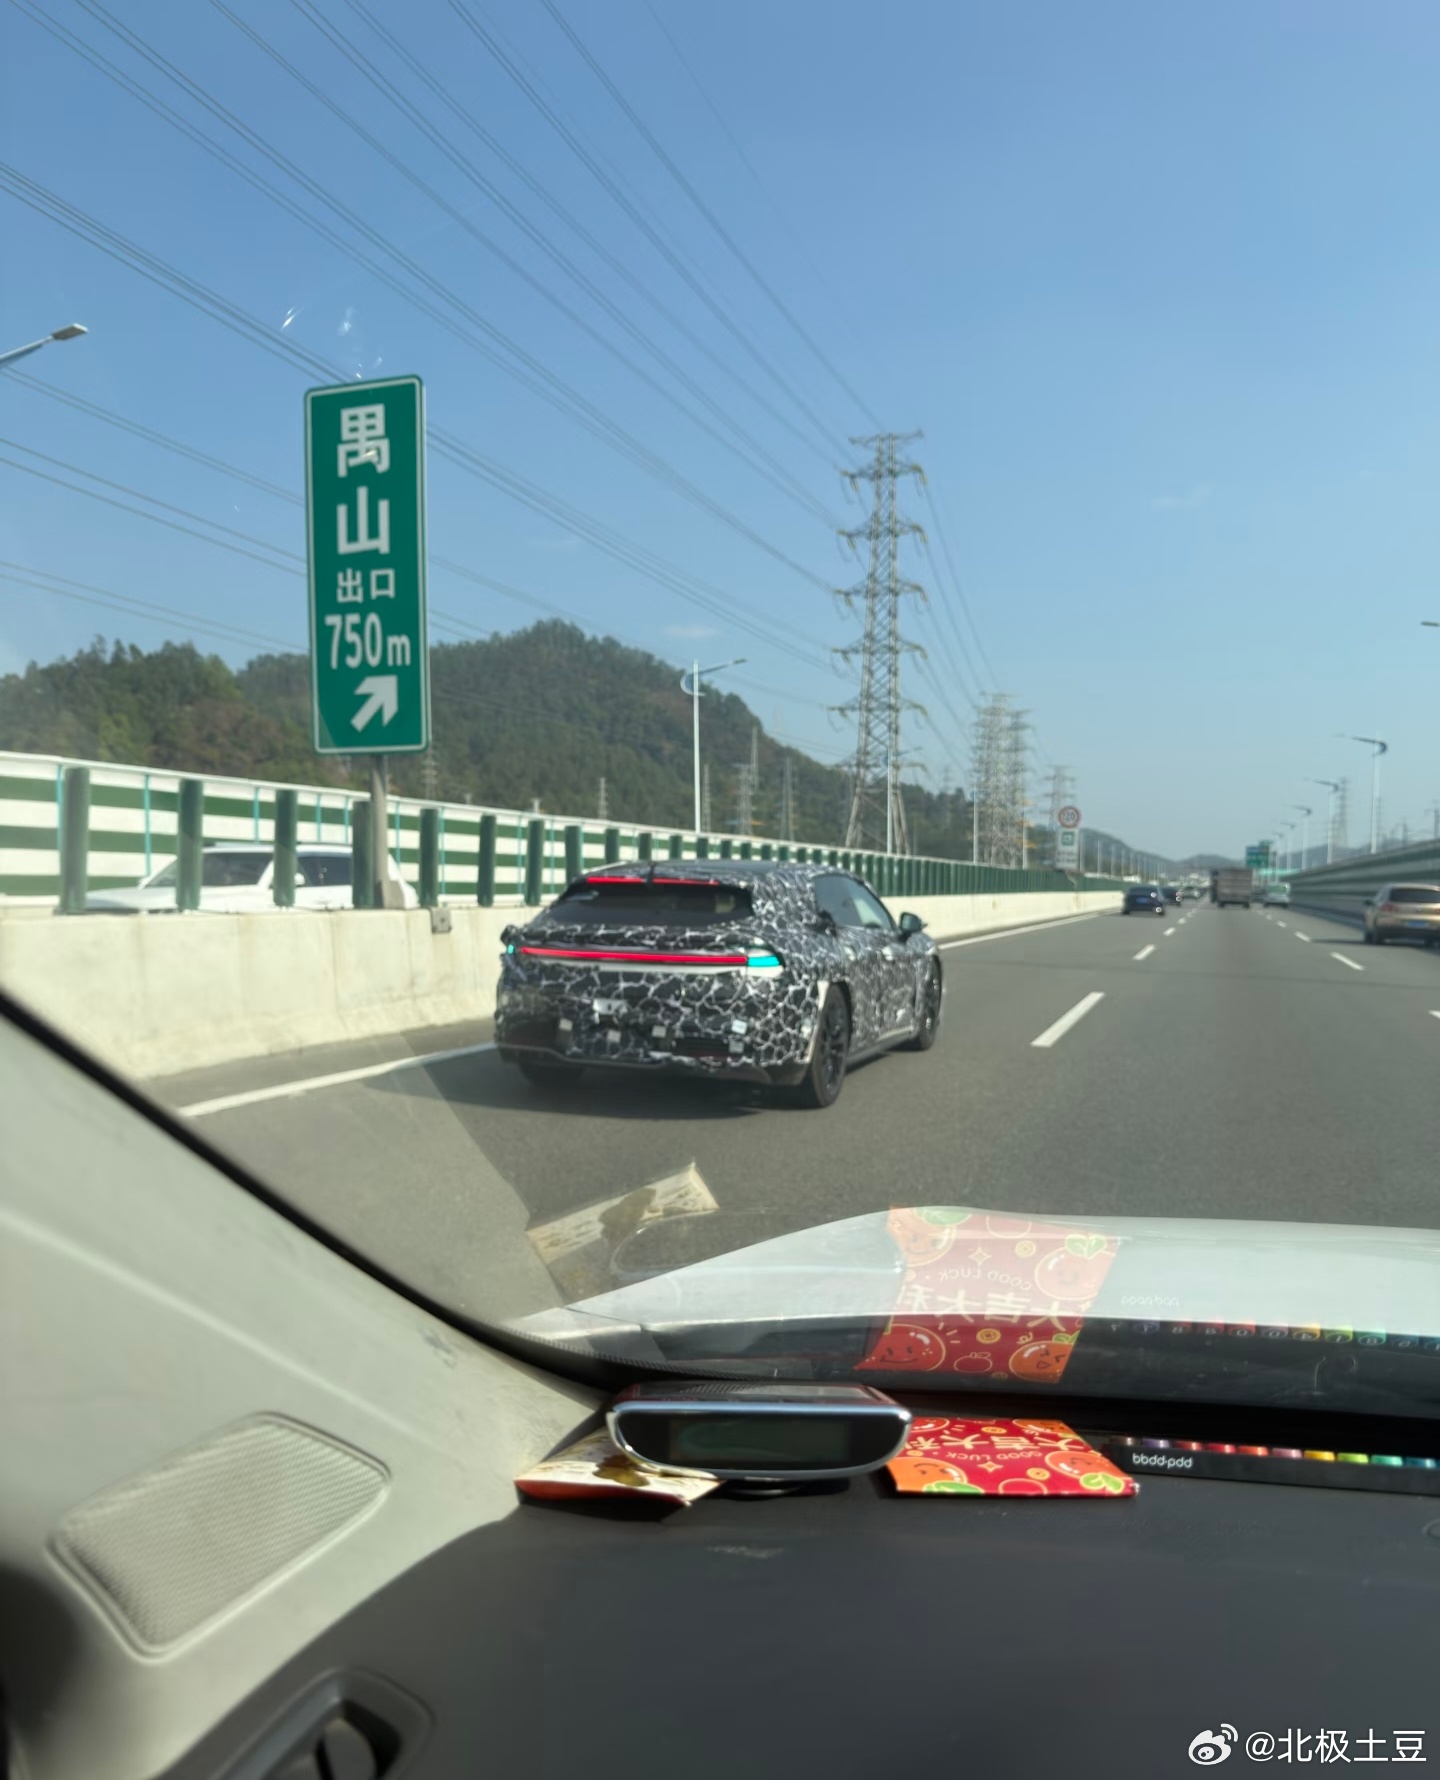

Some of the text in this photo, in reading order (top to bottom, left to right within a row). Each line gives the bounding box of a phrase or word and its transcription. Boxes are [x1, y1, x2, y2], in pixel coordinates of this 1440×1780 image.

[336, 403, 391, 555] 禺山
[336, 567, 396, 604] 出口
[324, 611, 412, 670] 750m
[947, 1451, 991, 1461] LUCK
